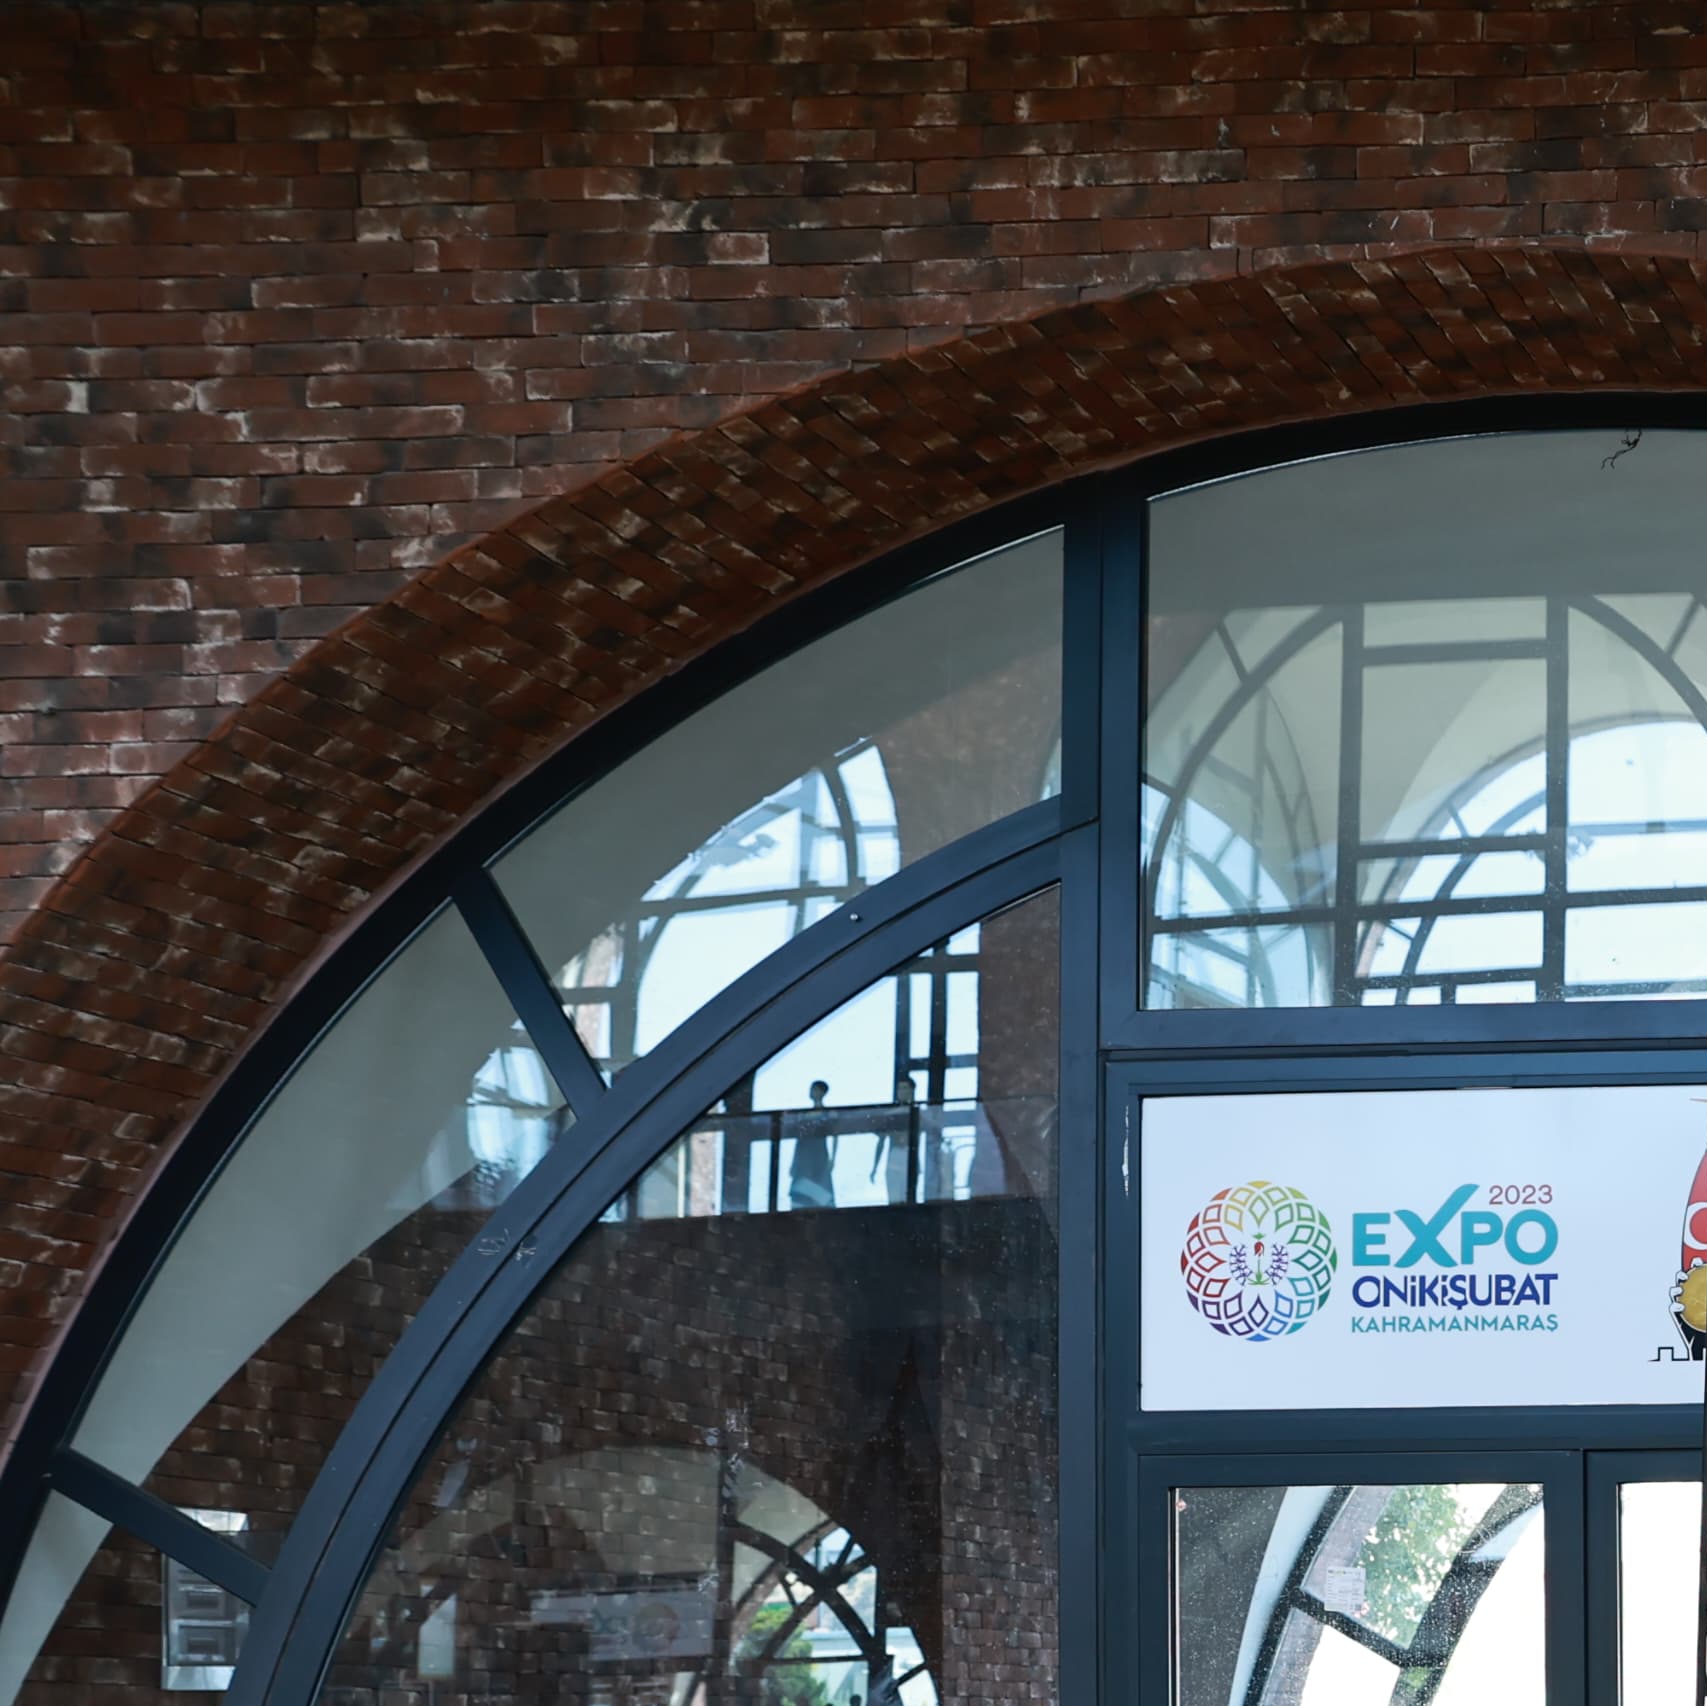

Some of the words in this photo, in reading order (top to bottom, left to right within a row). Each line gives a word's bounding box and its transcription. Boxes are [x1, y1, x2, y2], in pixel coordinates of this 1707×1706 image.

[1488, 1184, 1553, 1206] 2023
[1351, 1183, 1559, 1268] EXPO
[1351, 1314, 1559, 1334] KAHRAMANMARAŞ
